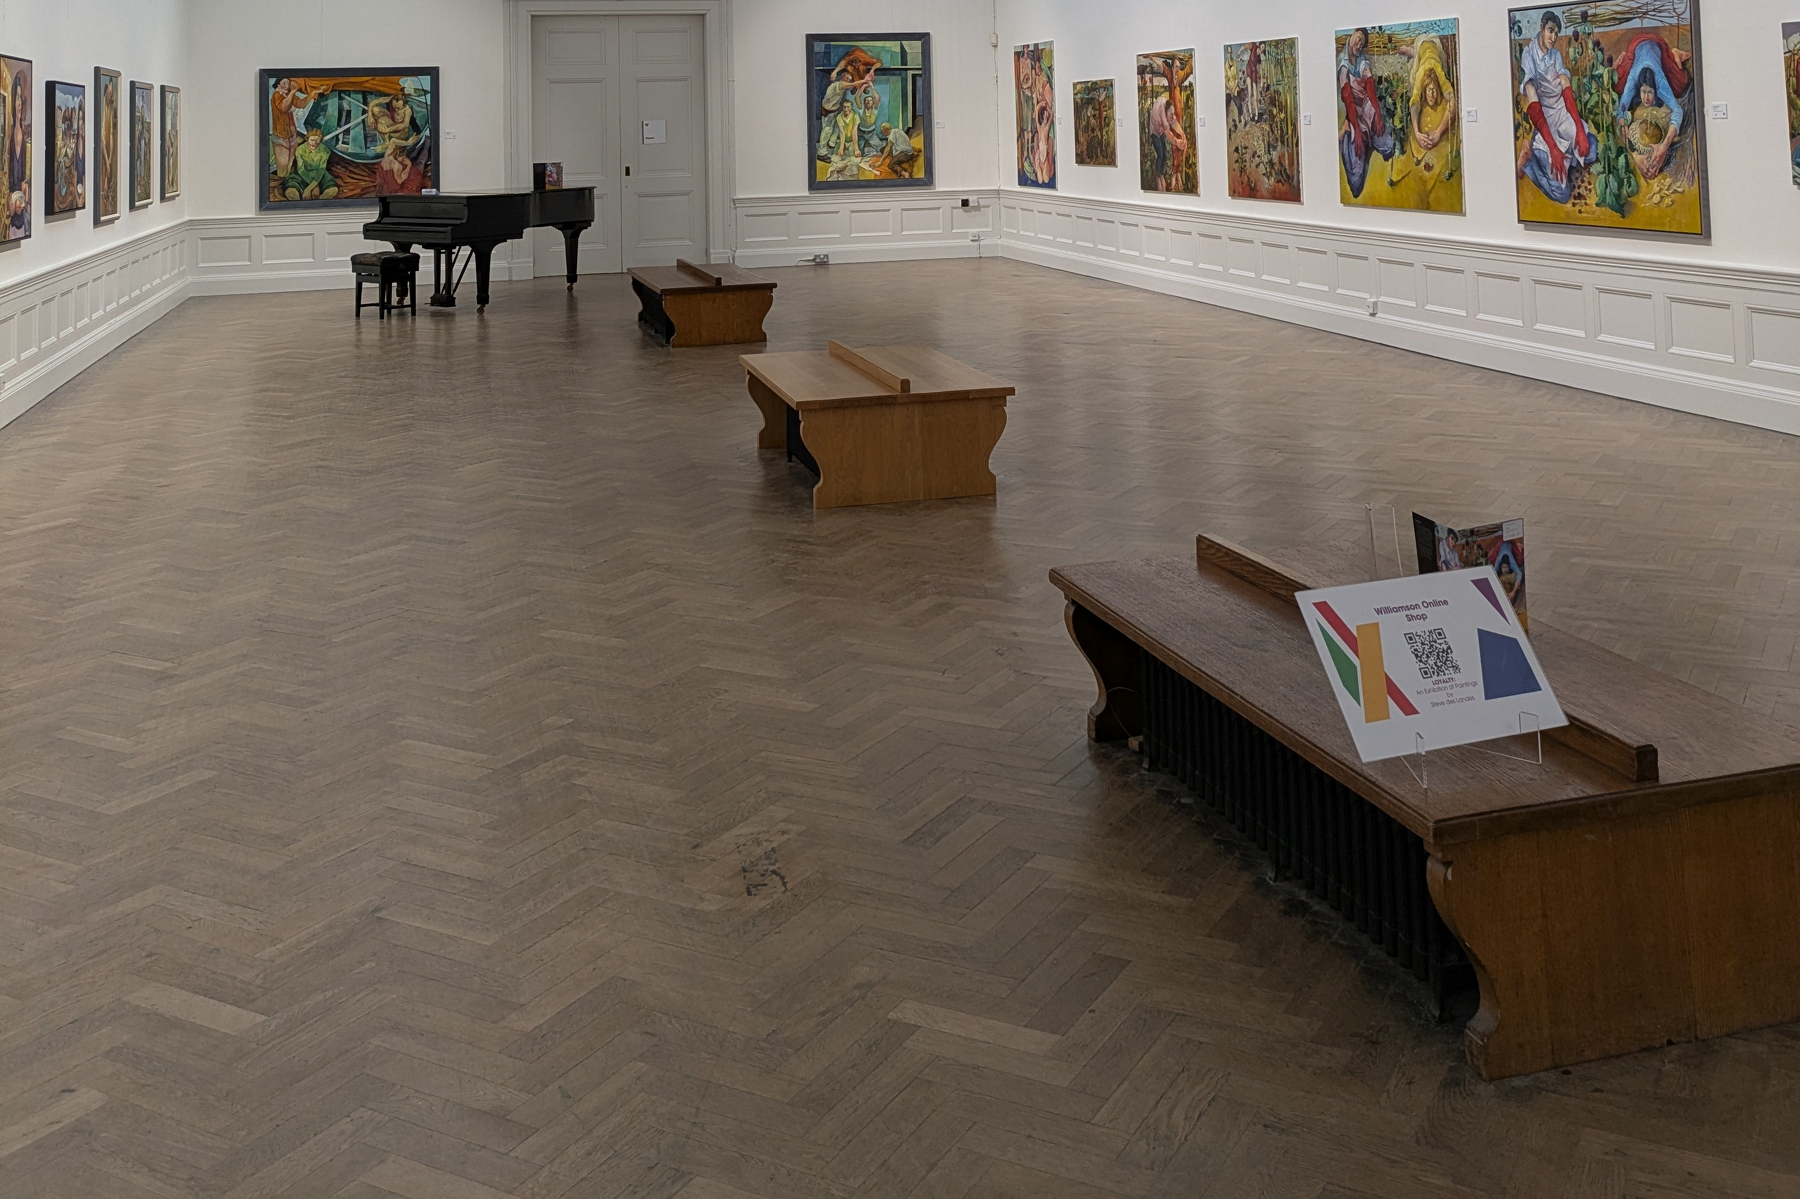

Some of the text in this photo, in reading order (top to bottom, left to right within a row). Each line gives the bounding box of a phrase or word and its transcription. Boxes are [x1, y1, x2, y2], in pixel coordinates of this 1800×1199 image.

[1373, 599, 1449, 616] Williamson Online
[1405, 613, 1428, 622] Shop
[1431, 677, 1457, 686] LOYALTY:
[1424, 685, 1449, 695] Exhibition
[1454, 681, 1478, 689] Paintings
